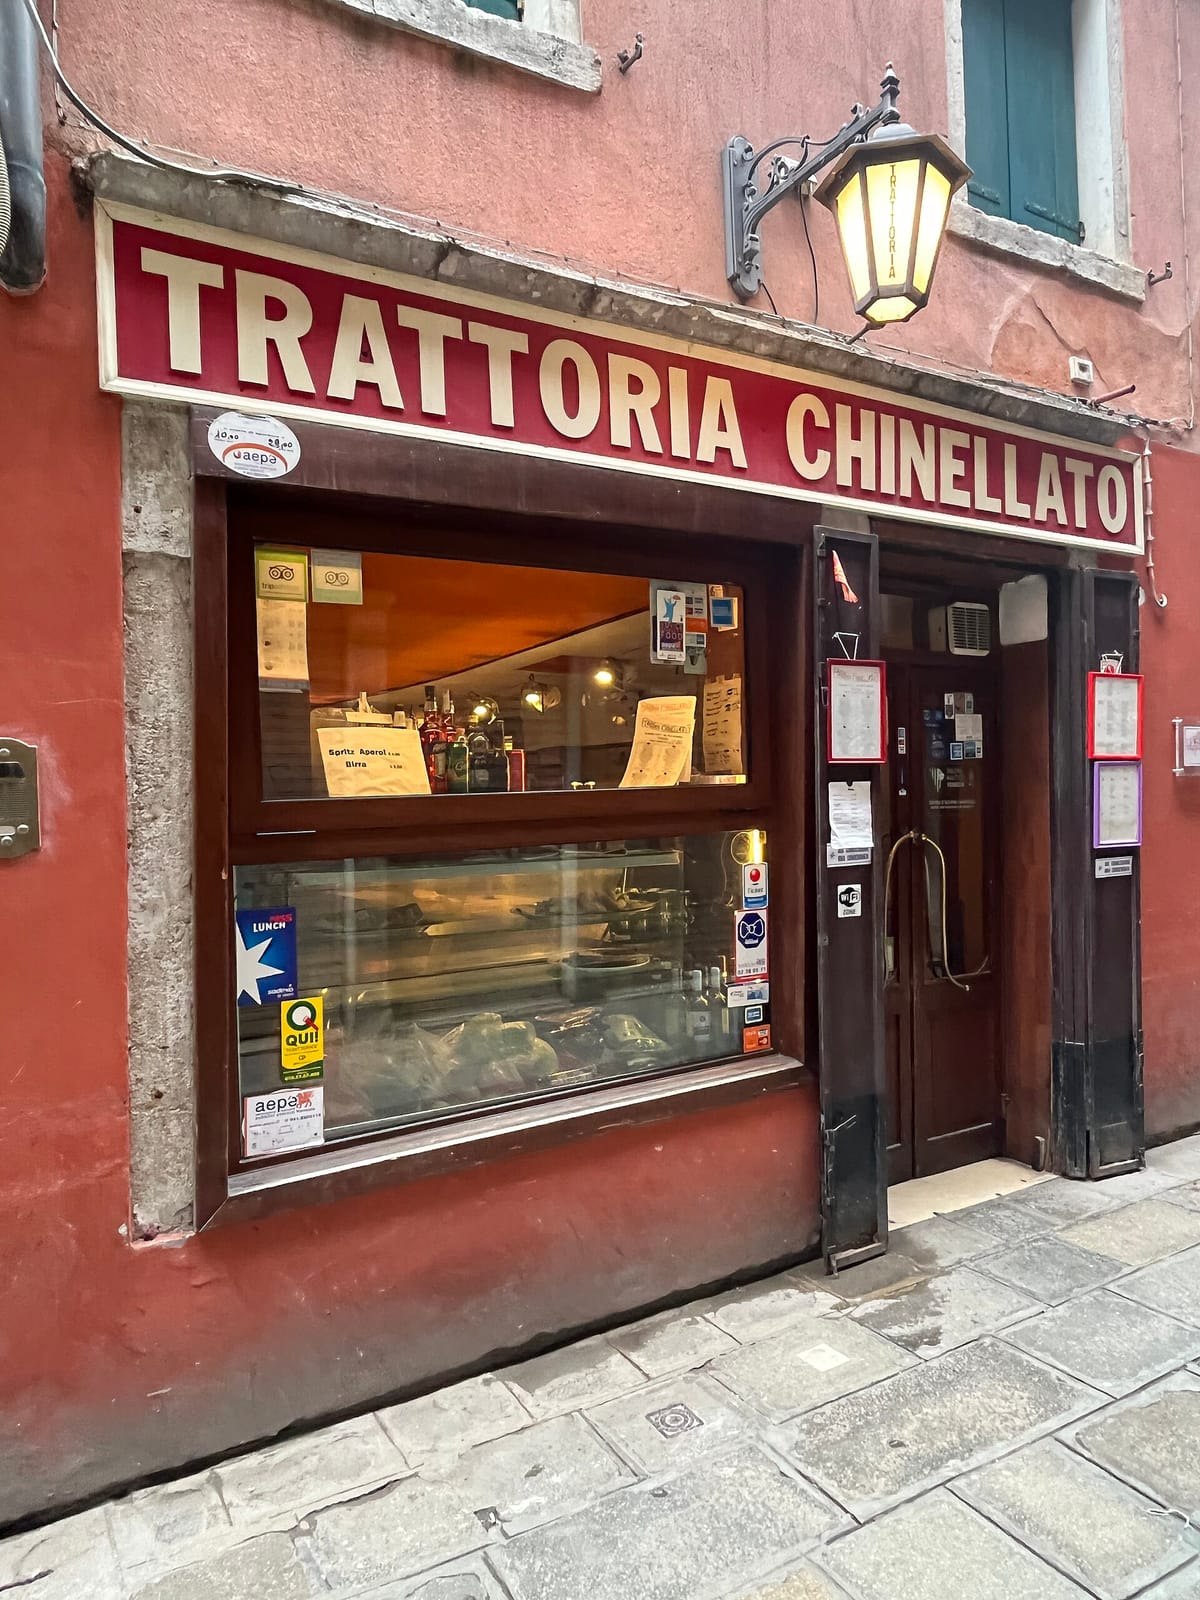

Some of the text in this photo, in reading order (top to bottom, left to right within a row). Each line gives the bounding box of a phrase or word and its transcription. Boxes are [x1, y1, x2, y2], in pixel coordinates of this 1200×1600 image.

[889, 164, 897, 279] TRATTORIA
[140, 246, 1128, 535] TRATTORIA CHINELLATO
[253, 921, 286, 933] LUNCH
[286, 1031, 319, 1047] QUI!
